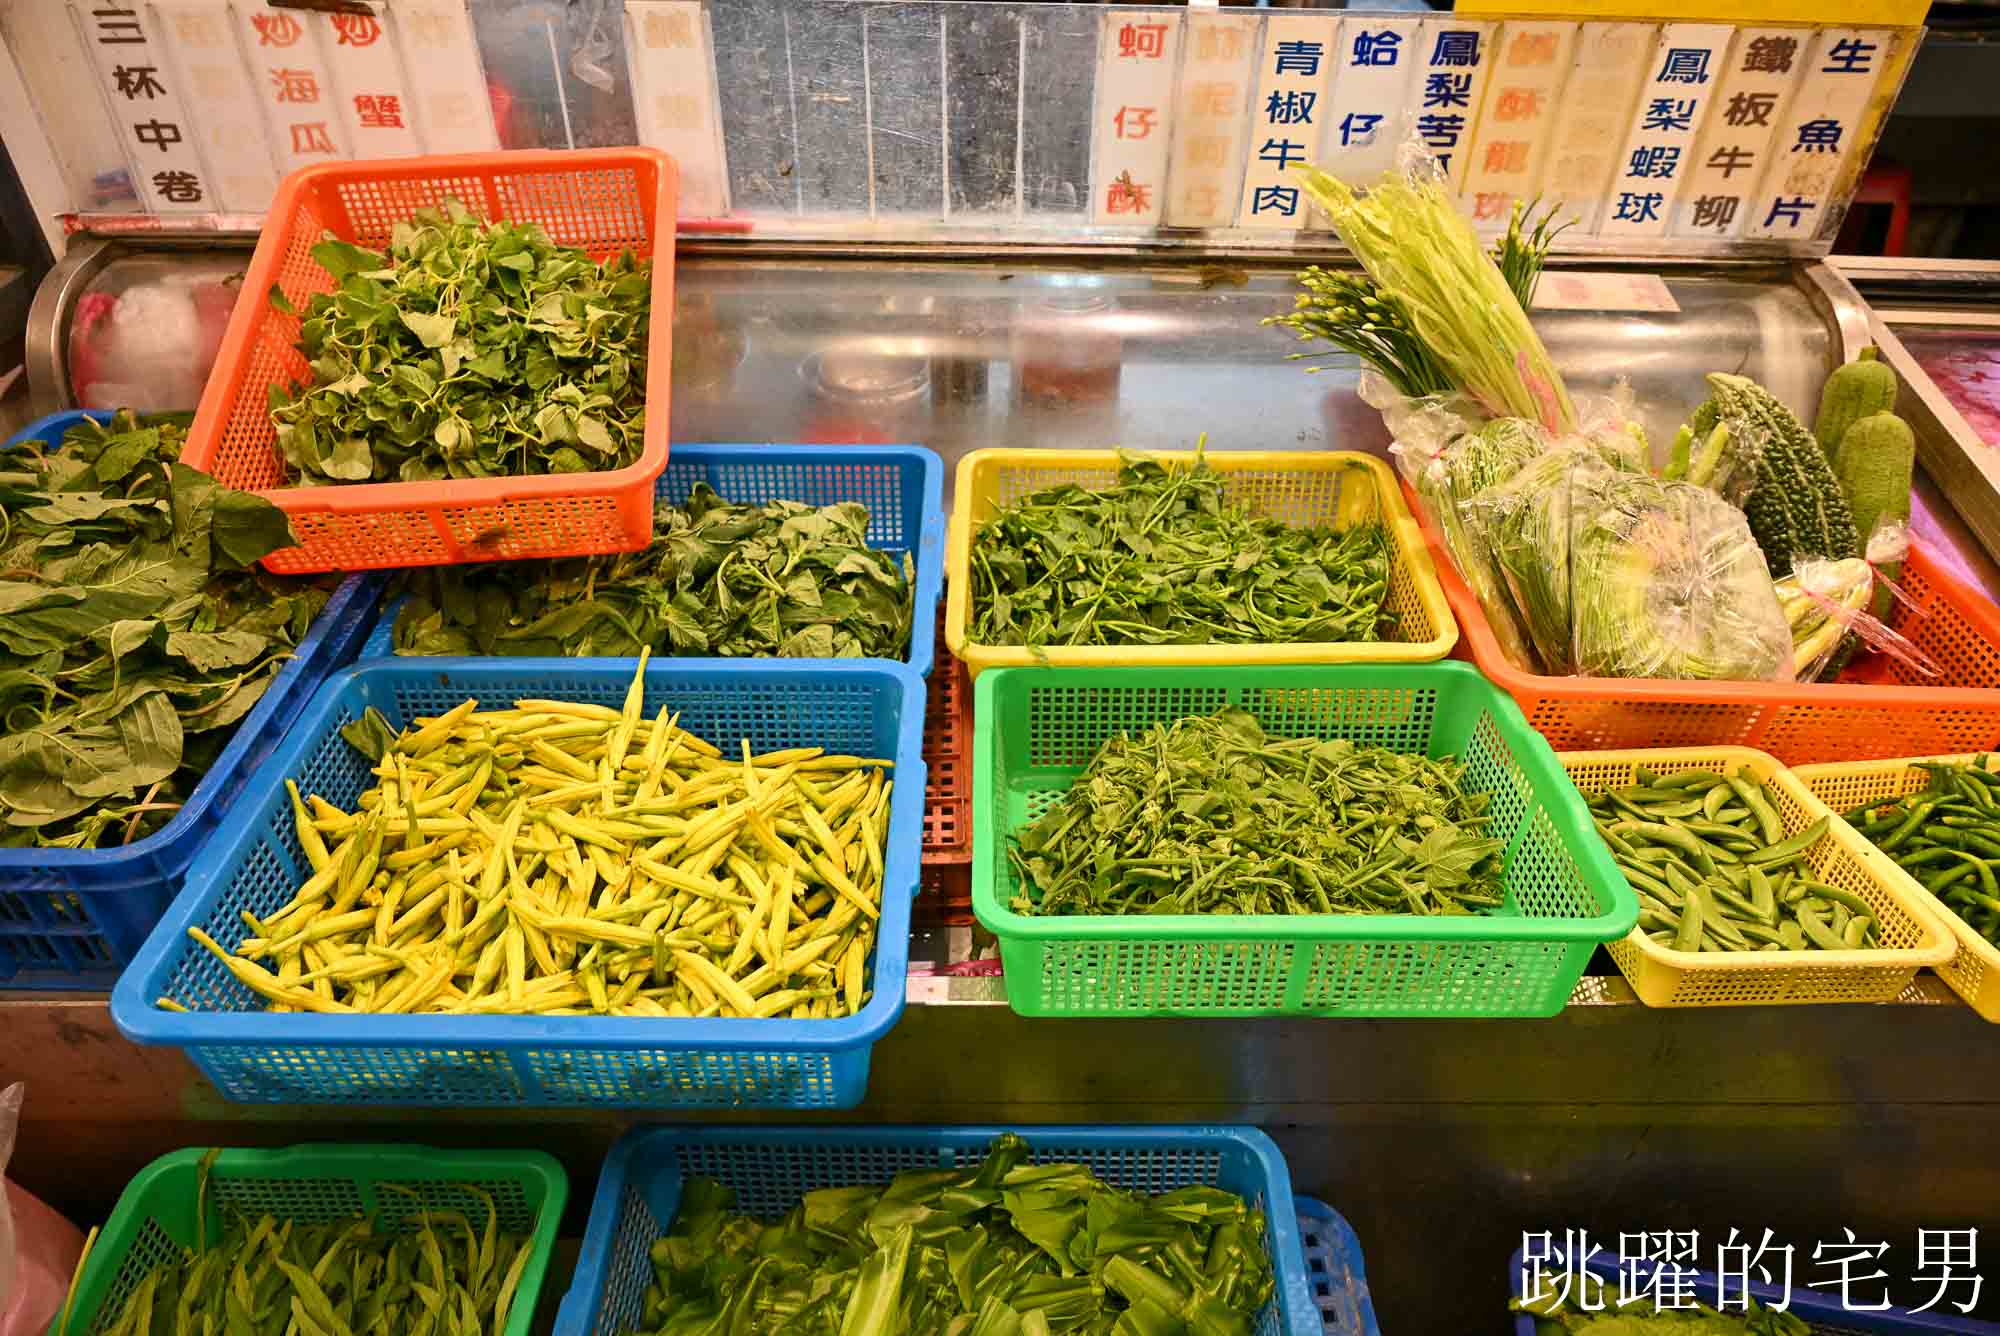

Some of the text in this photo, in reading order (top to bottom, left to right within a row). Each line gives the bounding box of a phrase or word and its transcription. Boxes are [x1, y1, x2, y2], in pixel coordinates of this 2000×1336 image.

[92, 8, 203, 203] 三杯中卷
[251, 12, 337, 154] 炒海瓜
[330, 13, 405, 129] 炒蟹
[1106, 23, 1168, 215] 蚵仔酥
[1252, 40, 1324, 217] 青椒牛肉
[1417, 30, 1481, 175] 鳳梨苦
[1612, 47, 1712, 224] 鳳梨蝦球
[1690, 36, 1798, 228] 鐵板牛柳
[1764, 38, 1877, 228] 生魚片
